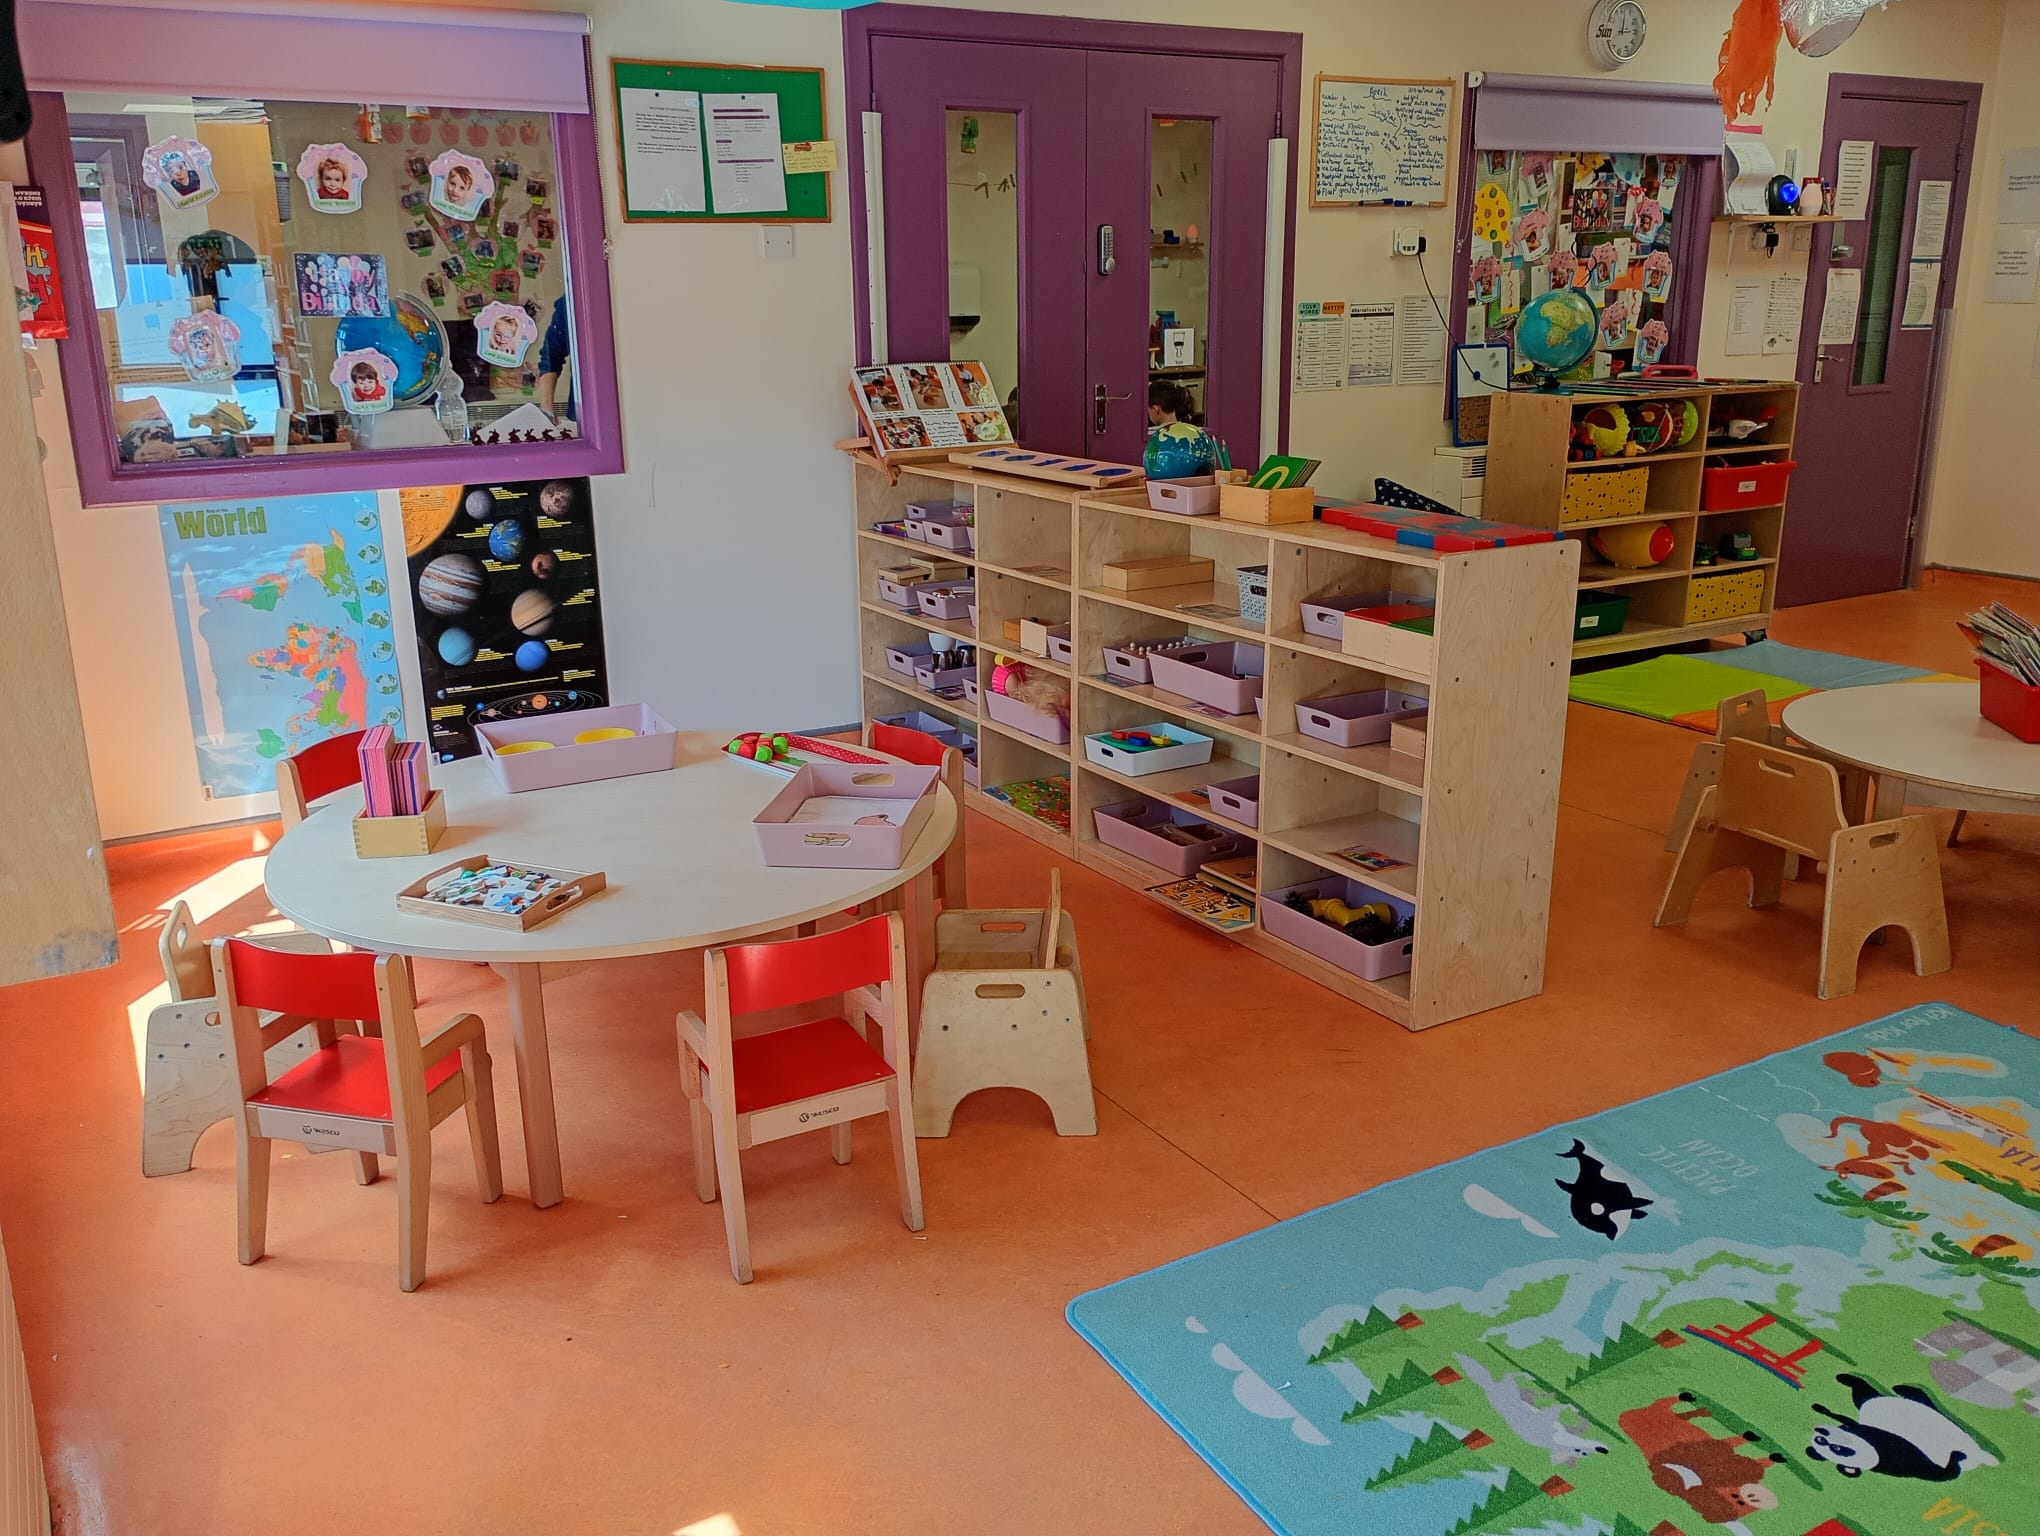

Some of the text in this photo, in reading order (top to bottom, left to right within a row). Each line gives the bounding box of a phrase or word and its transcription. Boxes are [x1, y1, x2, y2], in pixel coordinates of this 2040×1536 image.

[1595, 23, 1613, 39] Sun
[172, 506, 268, 540] World
[1678, 1138, 1760, 1178] OCEAN
